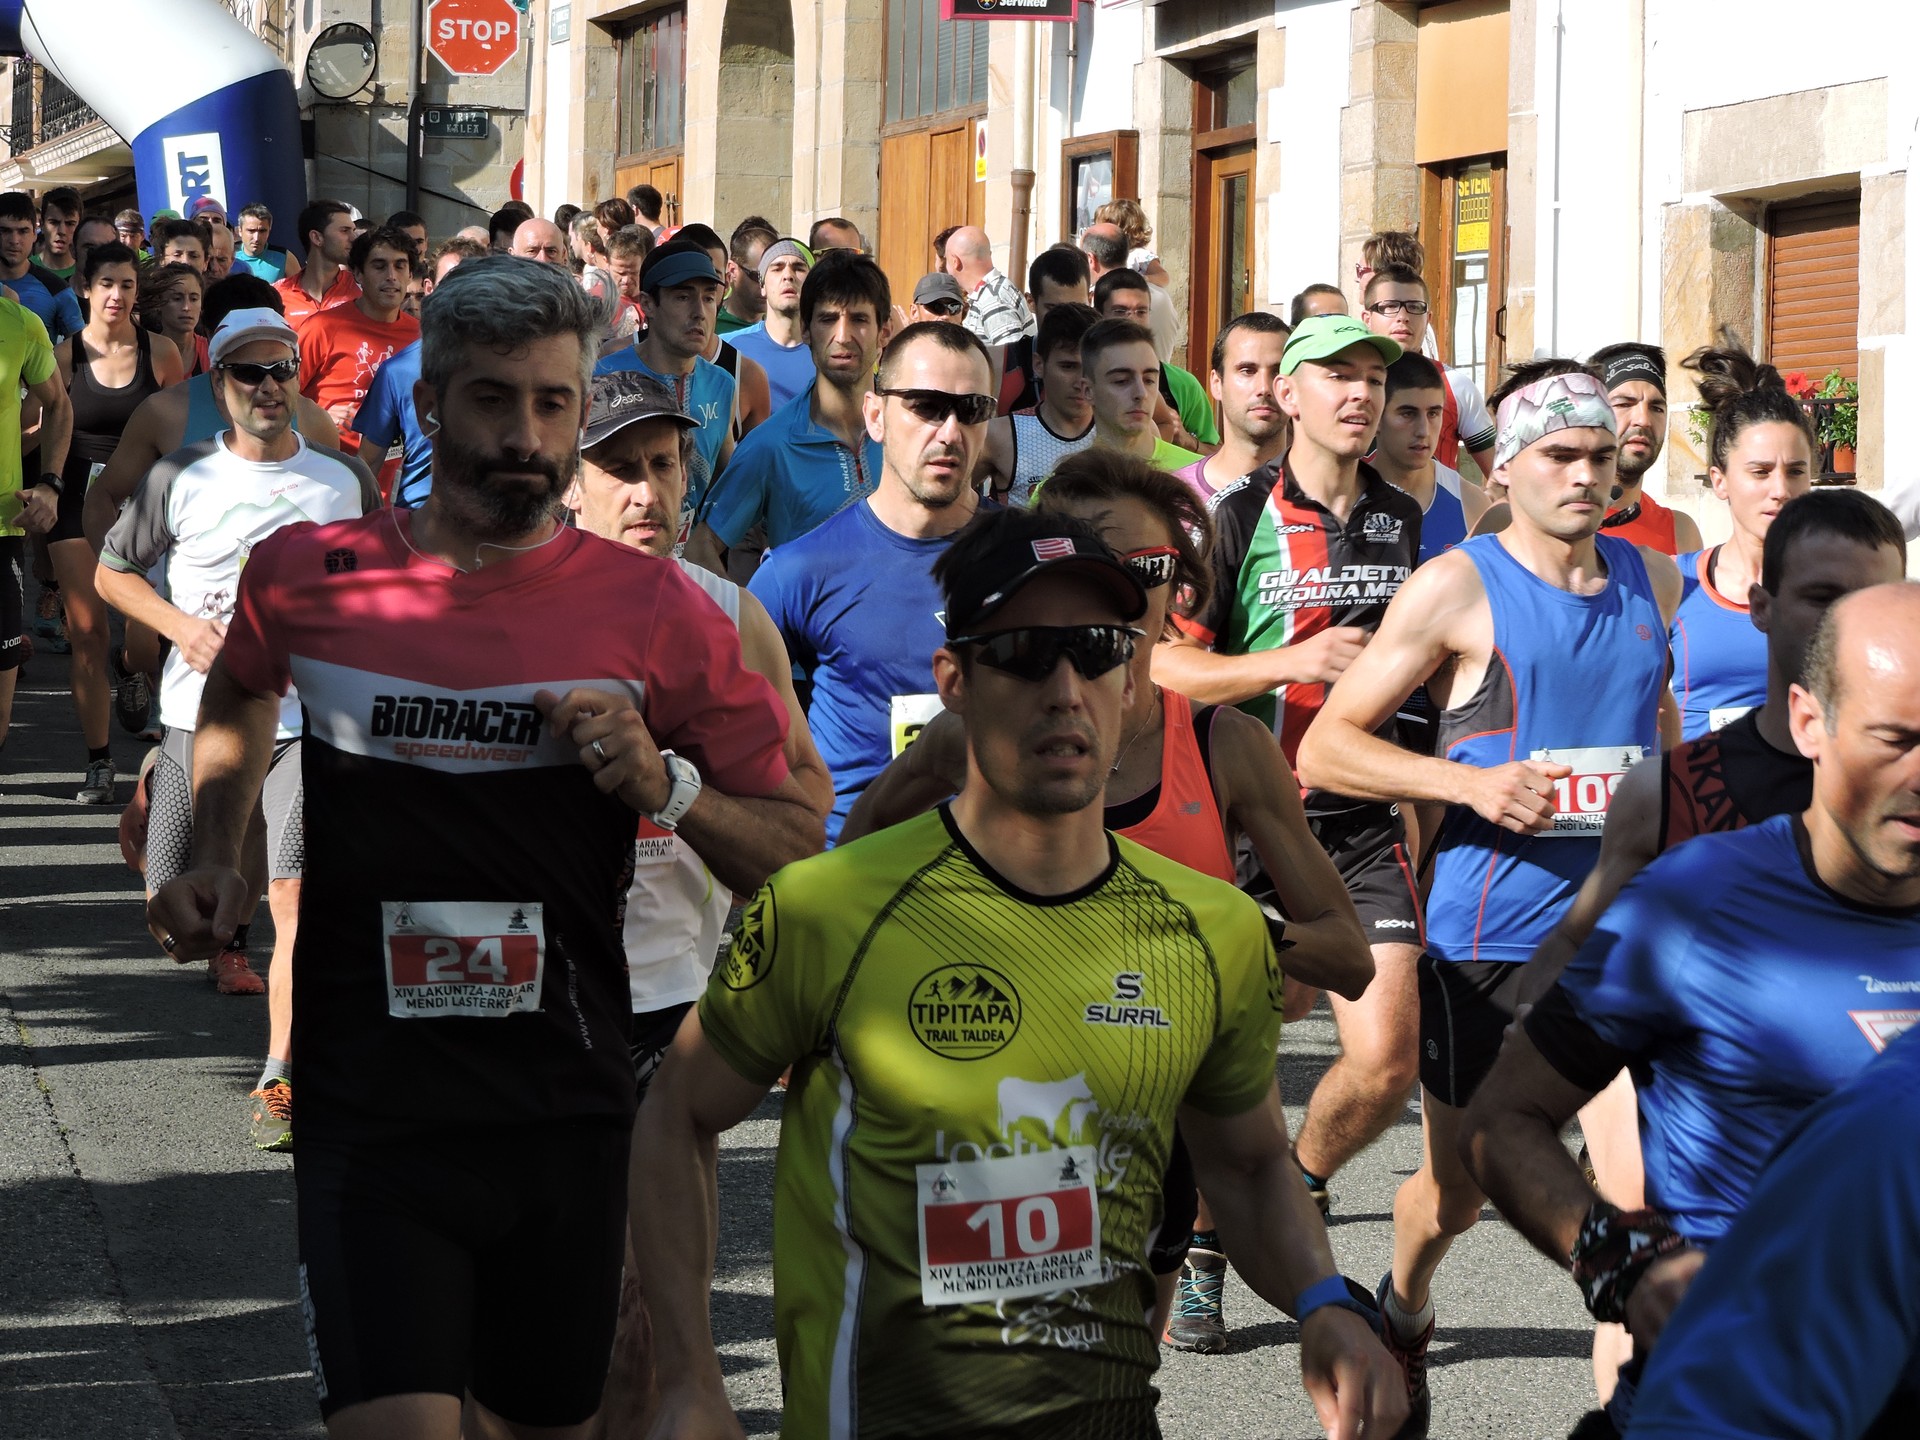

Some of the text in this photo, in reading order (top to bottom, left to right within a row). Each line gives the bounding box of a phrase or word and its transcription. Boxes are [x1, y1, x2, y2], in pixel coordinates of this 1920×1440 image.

[438, 19, 511, 41] STOP
[446, 124, 480, 133] KALEA
[2, 635, 23, 650] JOM
[395, 742, 533, 763] speedwear
[1552, 823, 1577, 831] ENDI
[424, 937, 508, 983] 24
[394, 983, 535, 998] XIV LAKUNTZA-ARALAR
[407, 996, 523, 1009] MENDI LASTERKETA
[913, 1004, 1015, 1024] TIPITAPA
[1084, 1004, 1170, 1027] SURAL
[924, 1029, 1006, 1042] TRAIL TALDEA
[966, 1196, 1060, 1259] 10
[929, 1266, 952, 1281] XIV
[957, 1249, 1093, 1278] LAKUNTZA-ARALAR
[943, 1279, 991, 1293] MENDI
[996, 1265, 1085, 1289] LASTERKETA
